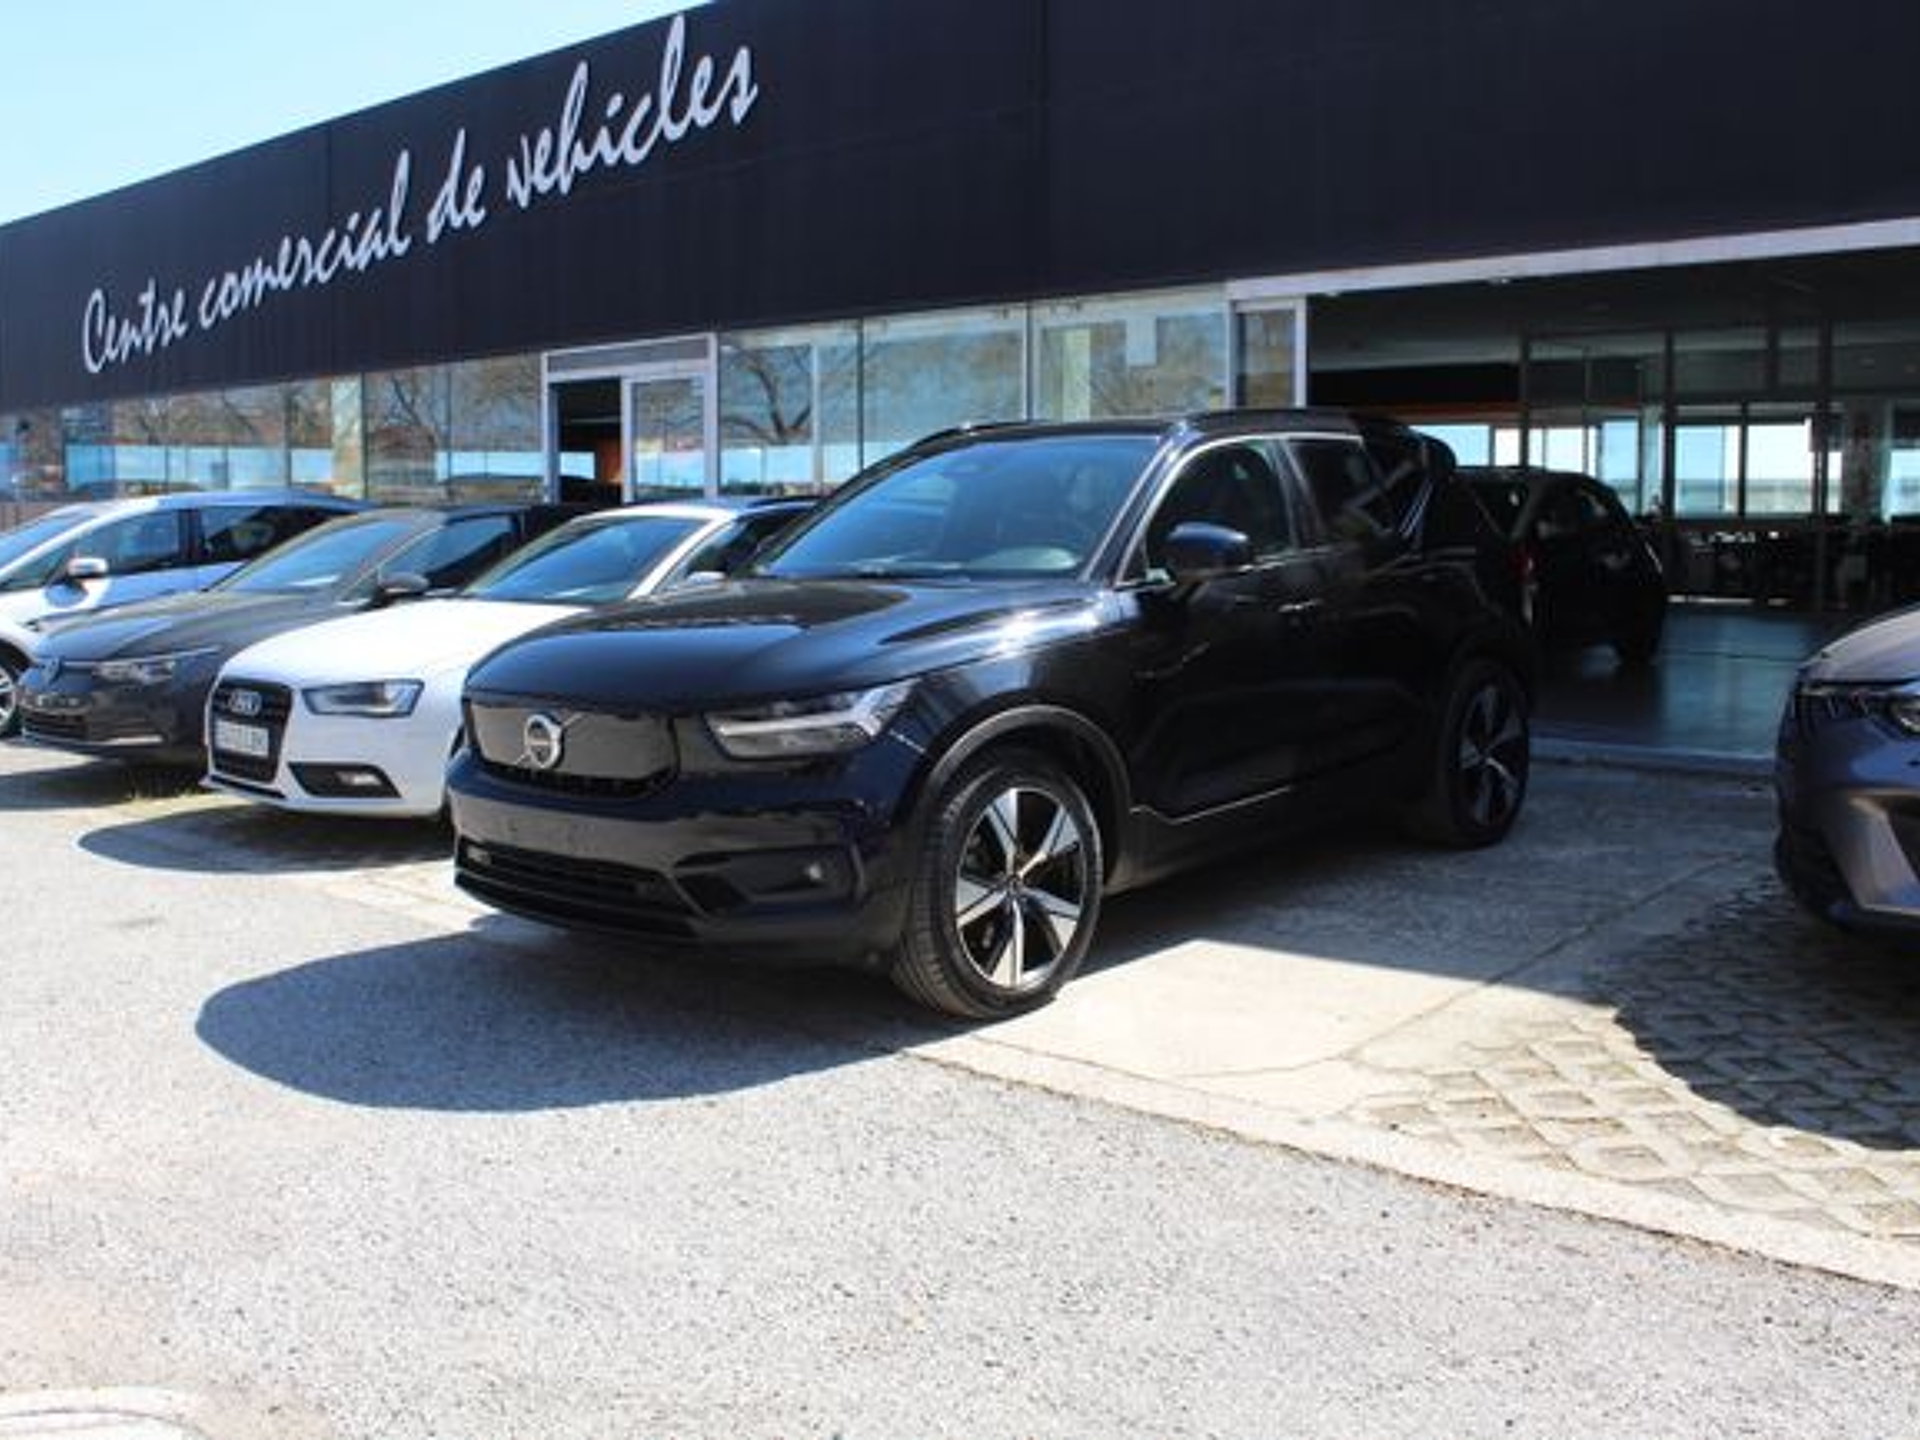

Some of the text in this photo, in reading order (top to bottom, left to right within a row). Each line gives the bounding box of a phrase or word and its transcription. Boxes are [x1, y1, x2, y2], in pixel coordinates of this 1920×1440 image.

[83, 13, 758, 374] Centre comercial de vehicles
